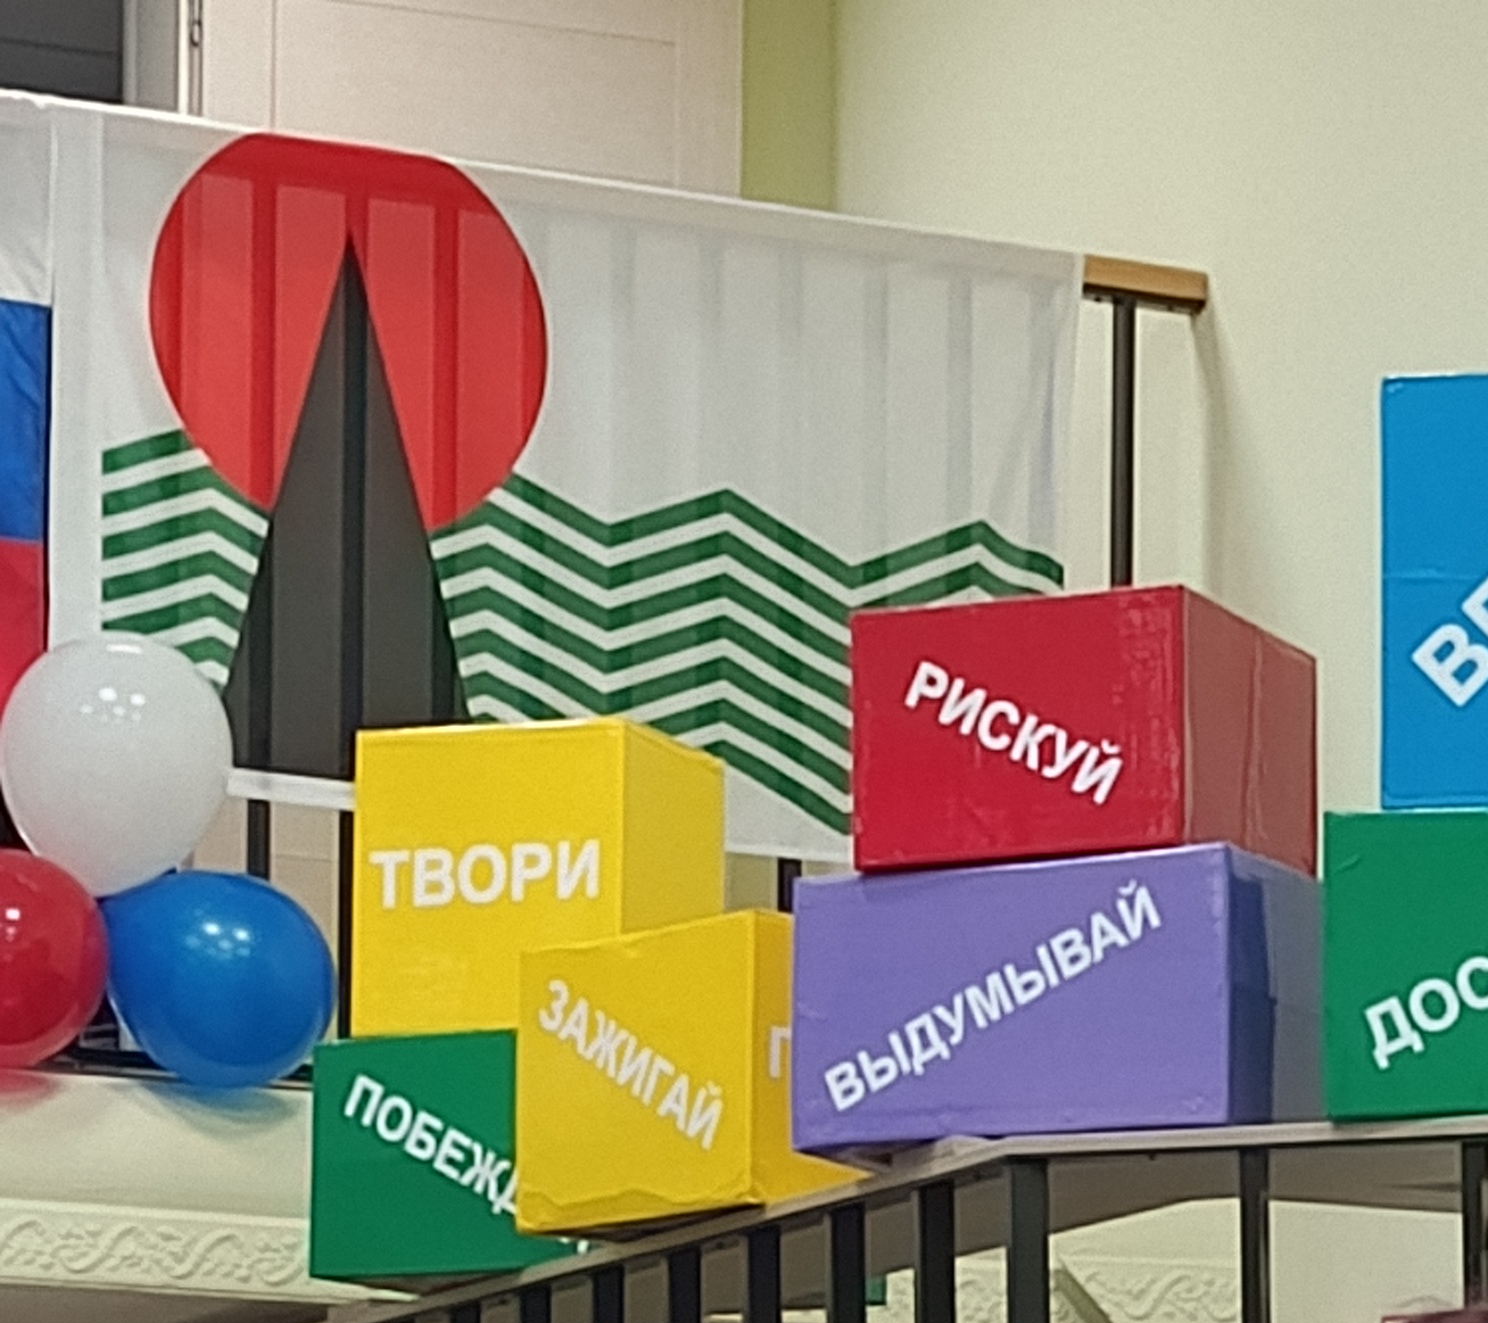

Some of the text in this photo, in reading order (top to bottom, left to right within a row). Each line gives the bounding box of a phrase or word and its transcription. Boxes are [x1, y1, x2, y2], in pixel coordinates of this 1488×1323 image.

[904, 660, 1124, 805] РИСКУЙ
[369, 838, 601, 910] ТВОРИ
[538, 979, 723, 1150] ЗАЖИГАЙ
[823, 878, 1162, 1112] ВЫДУМЫВАЙ
